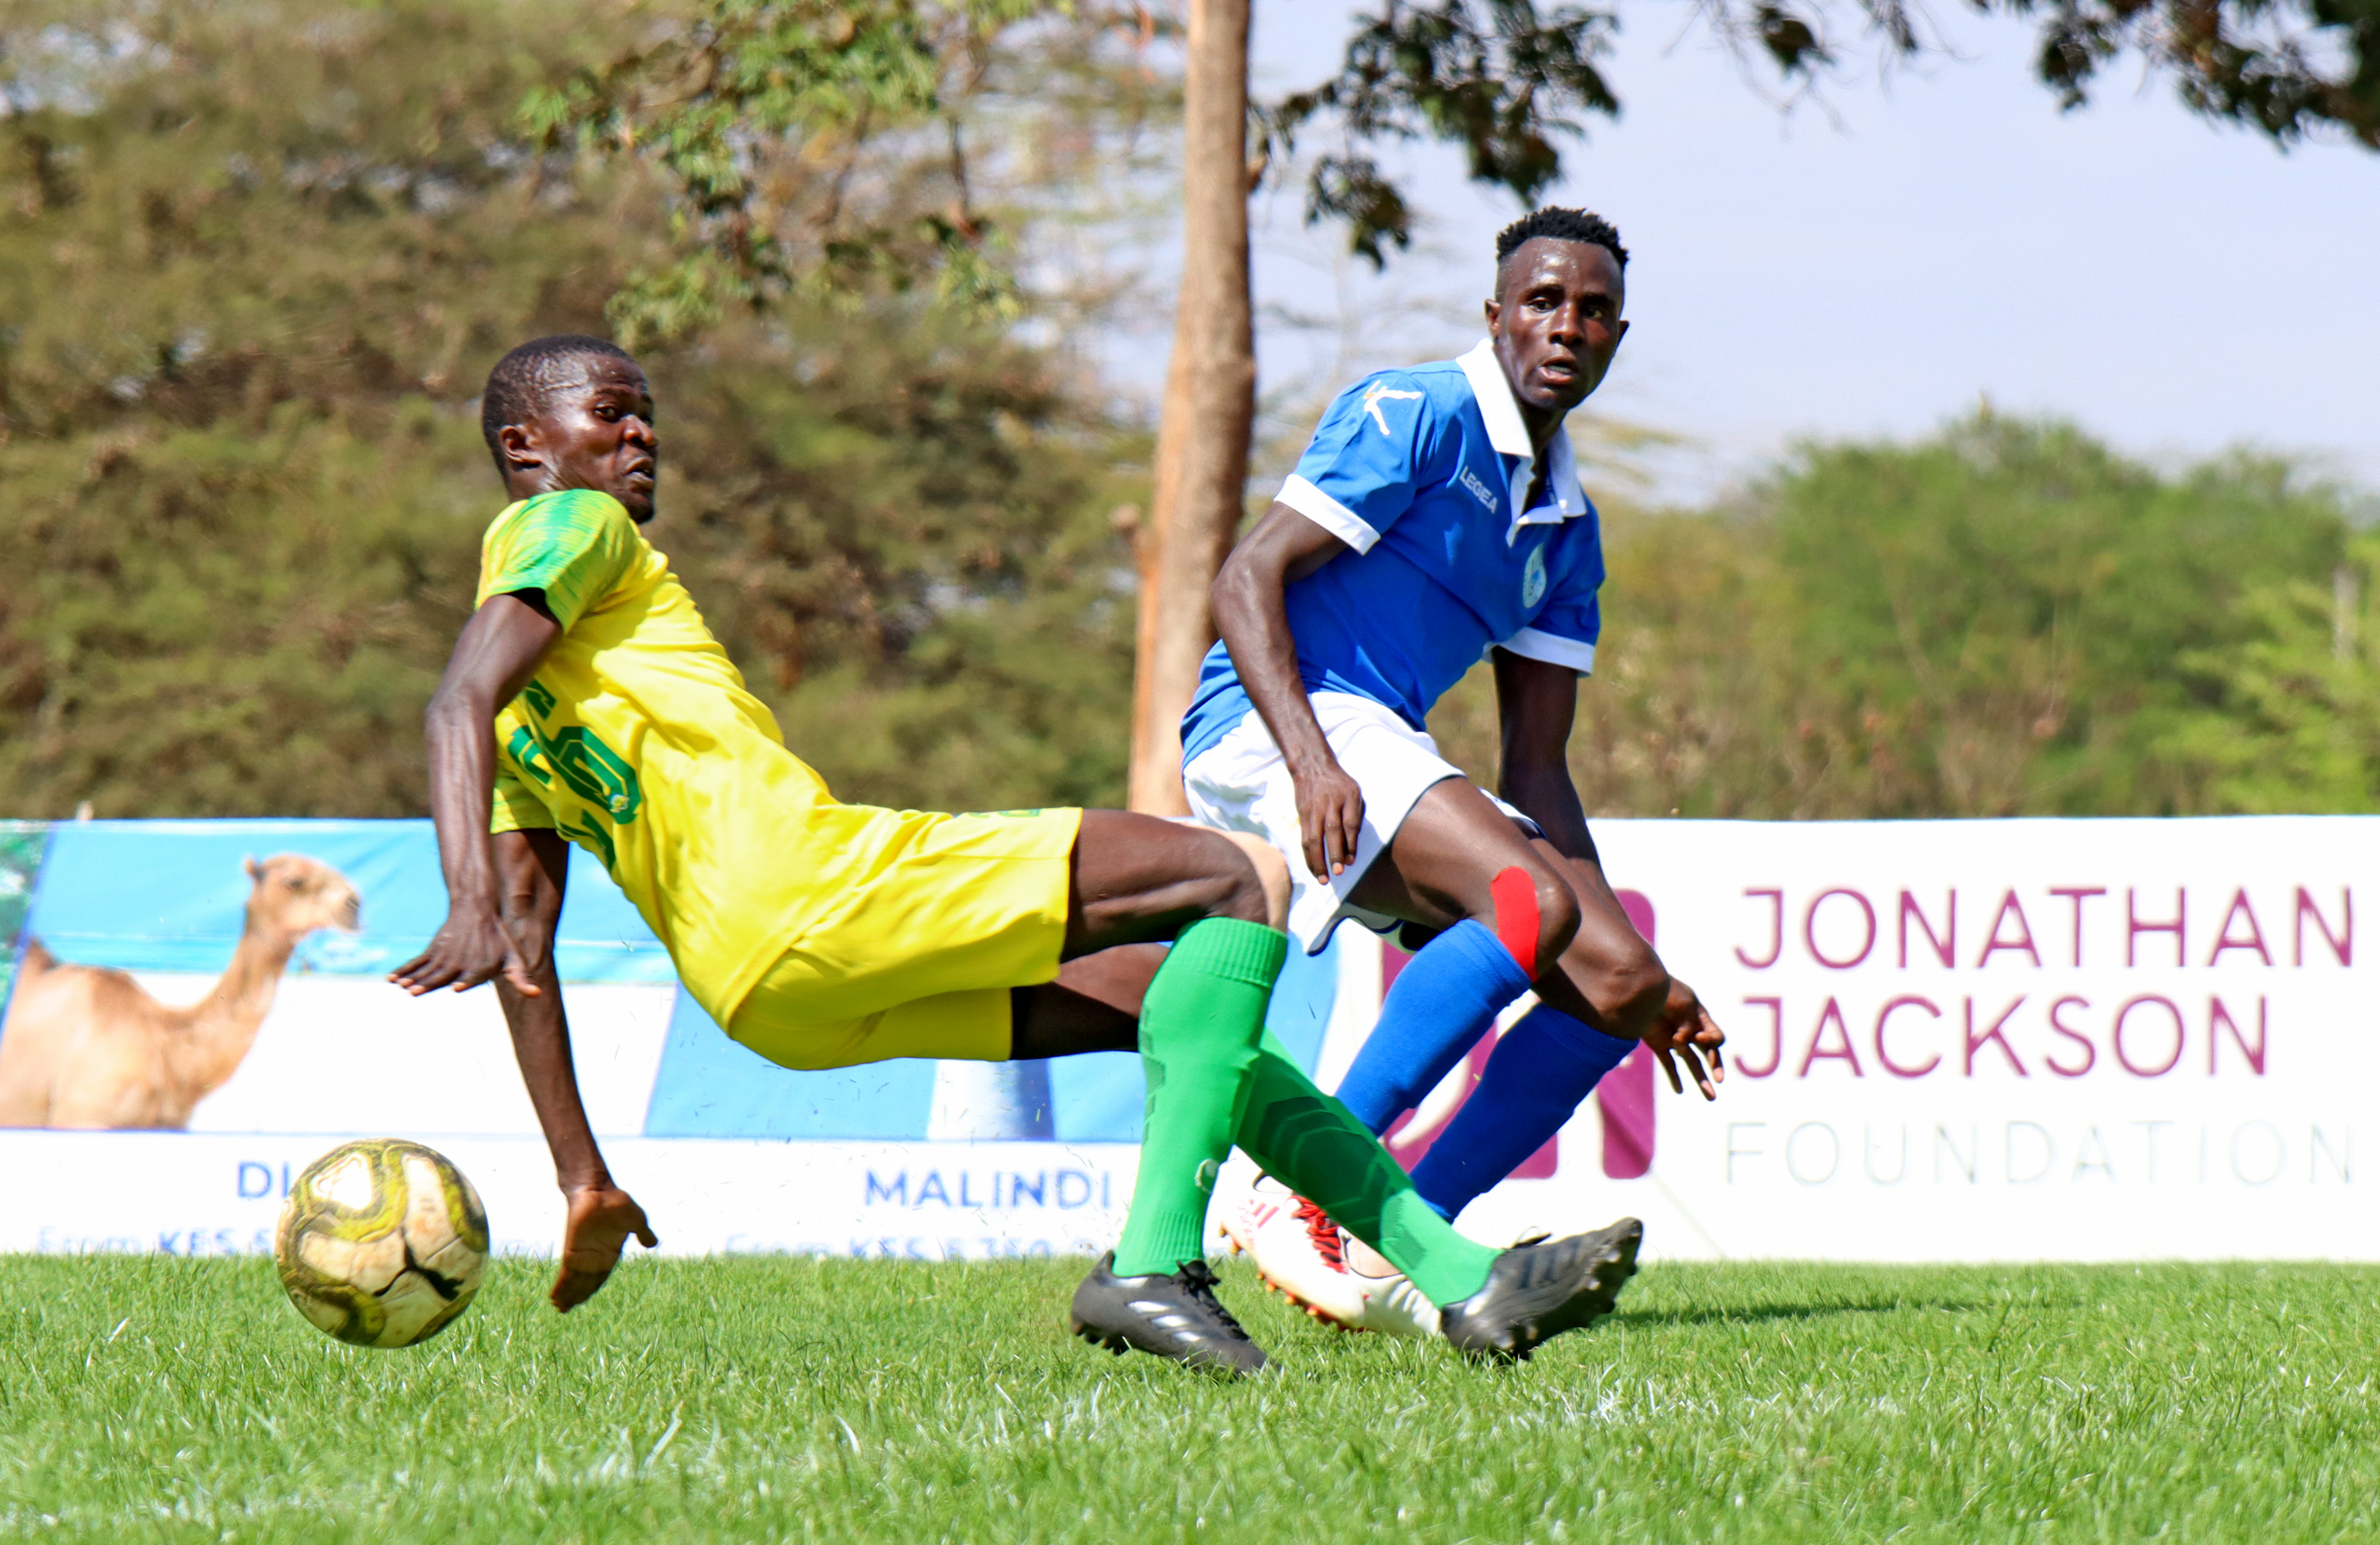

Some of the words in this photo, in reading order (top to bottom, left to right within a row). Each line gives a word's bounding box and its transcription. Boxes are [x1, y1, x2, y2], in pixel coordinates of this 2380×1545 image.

[1459, 465, 1498, 514] LEGEA
[1732, 885, 2355, 971] JONATHAN
[1732, 993, 2271, 1079] JACKSON
[1724, 1119, 2357, 1187] FOUNDATION
[864, 1166, 1111, 1209] MALINDI
